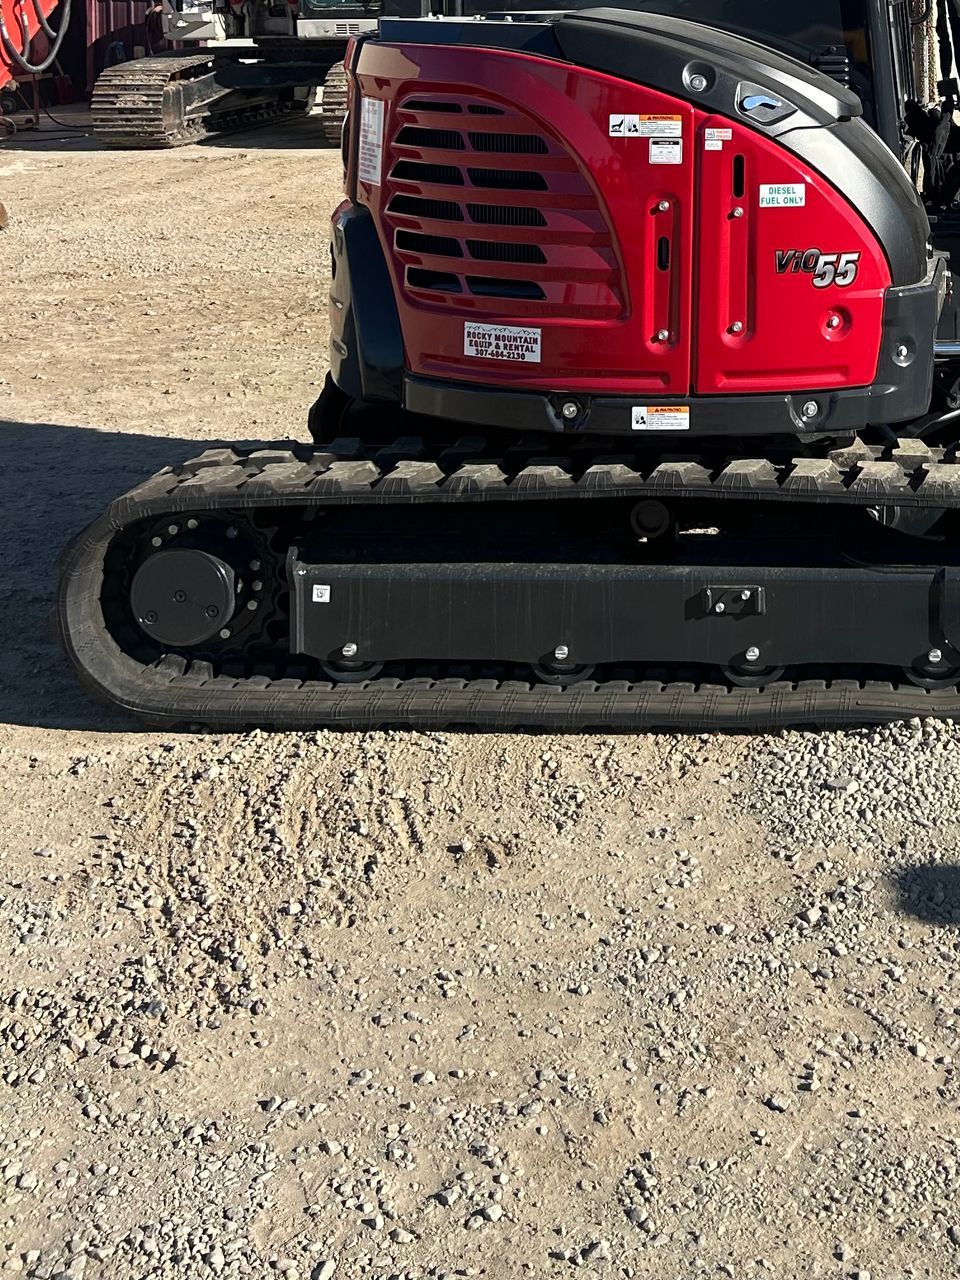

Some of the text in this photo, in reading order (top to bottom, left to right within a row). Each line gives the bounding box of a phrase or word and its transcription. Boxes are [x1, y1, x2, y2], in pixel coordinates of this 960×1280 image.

[768, 186, 797, 195] DIESEL
[760, 196, 804, 205] FUEL ONLY
[467, 331, 538, 345] ROCKY MOUNTAIN
[469, 340, 492, 349] EQUIP
[503, 343, 536, 353] RENTAL
[475, 349, 526, 360] 307-684-2130
